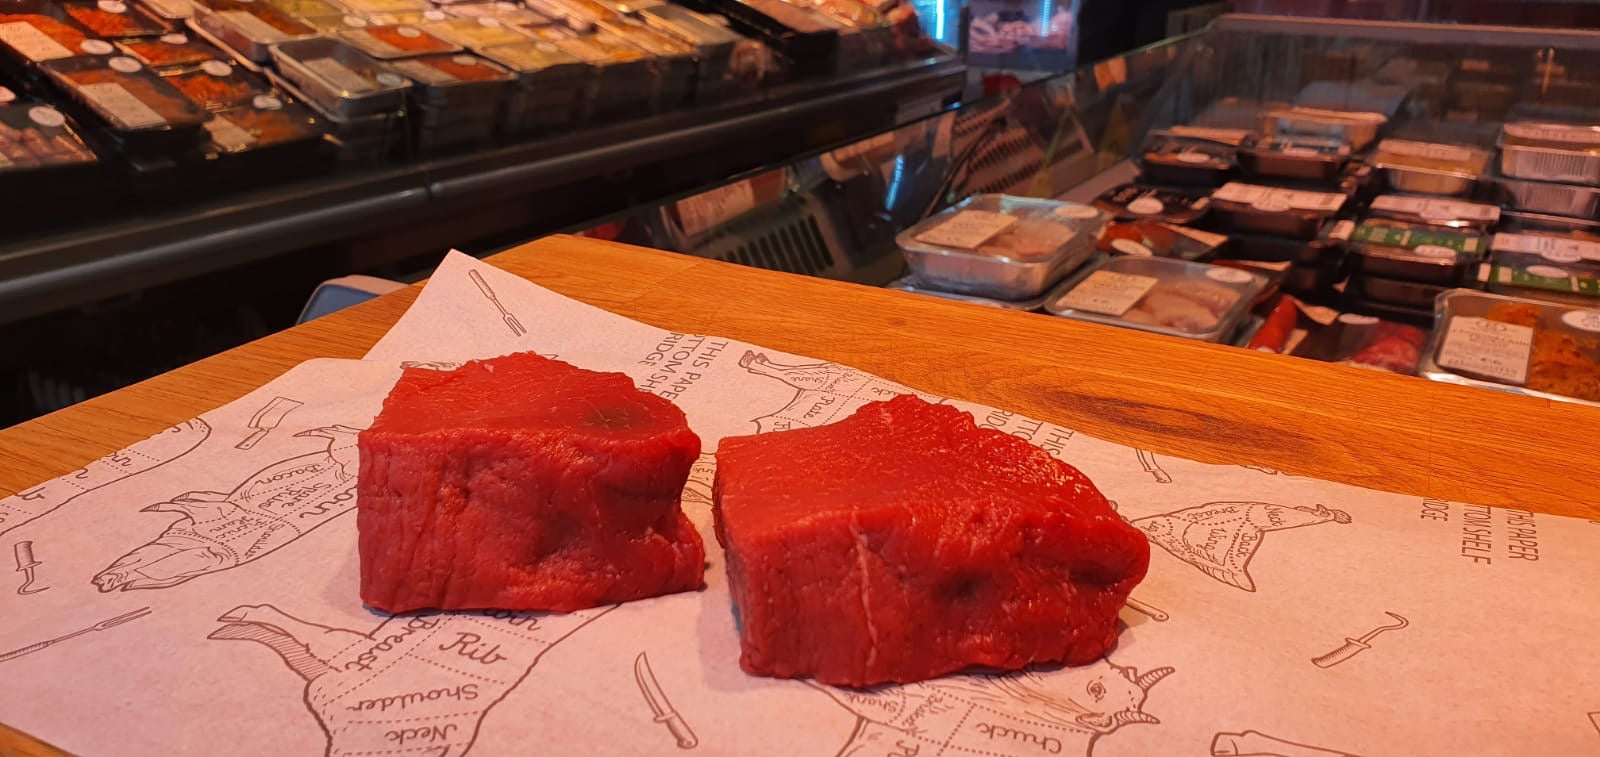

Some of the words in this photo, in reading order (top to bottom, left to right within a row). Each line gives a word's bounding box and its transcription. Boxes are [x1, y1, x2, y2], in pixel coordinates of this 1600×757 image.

[692, 341, 729, 369] THIS
[661, 371, 702, 400] PAPE
[871, 387, 897, 396] uck
[803, 395, 836, 420] Plate
[1039, 427, 1074, 455] THIS
[254, 463, 326, 485] Bacon
[281, 483, 332, 509] Spare
[299, 485, 358, 519] oin
[1187, 506, 1239, 521] Breast
[1264, 504, 1287, 527] Neck
[1463, 503, 1492, 528] TTOM
[1195, 526, 1228, 552] Wing
[1236, 530, 1259, 558] Back
[1461, 527, 1491, 565] SHELF
[1508, 526, 1540, 562] PAPER
[345, 616, 440, 672] Breast
[439, 632, 508, 665] Rib
[345, 683, 480, 712] Shoulder
[844, 693, 899, 713] Shank
[384, 723, 458, 745] Neck
[976, 722, 1062, 755] Chuck
